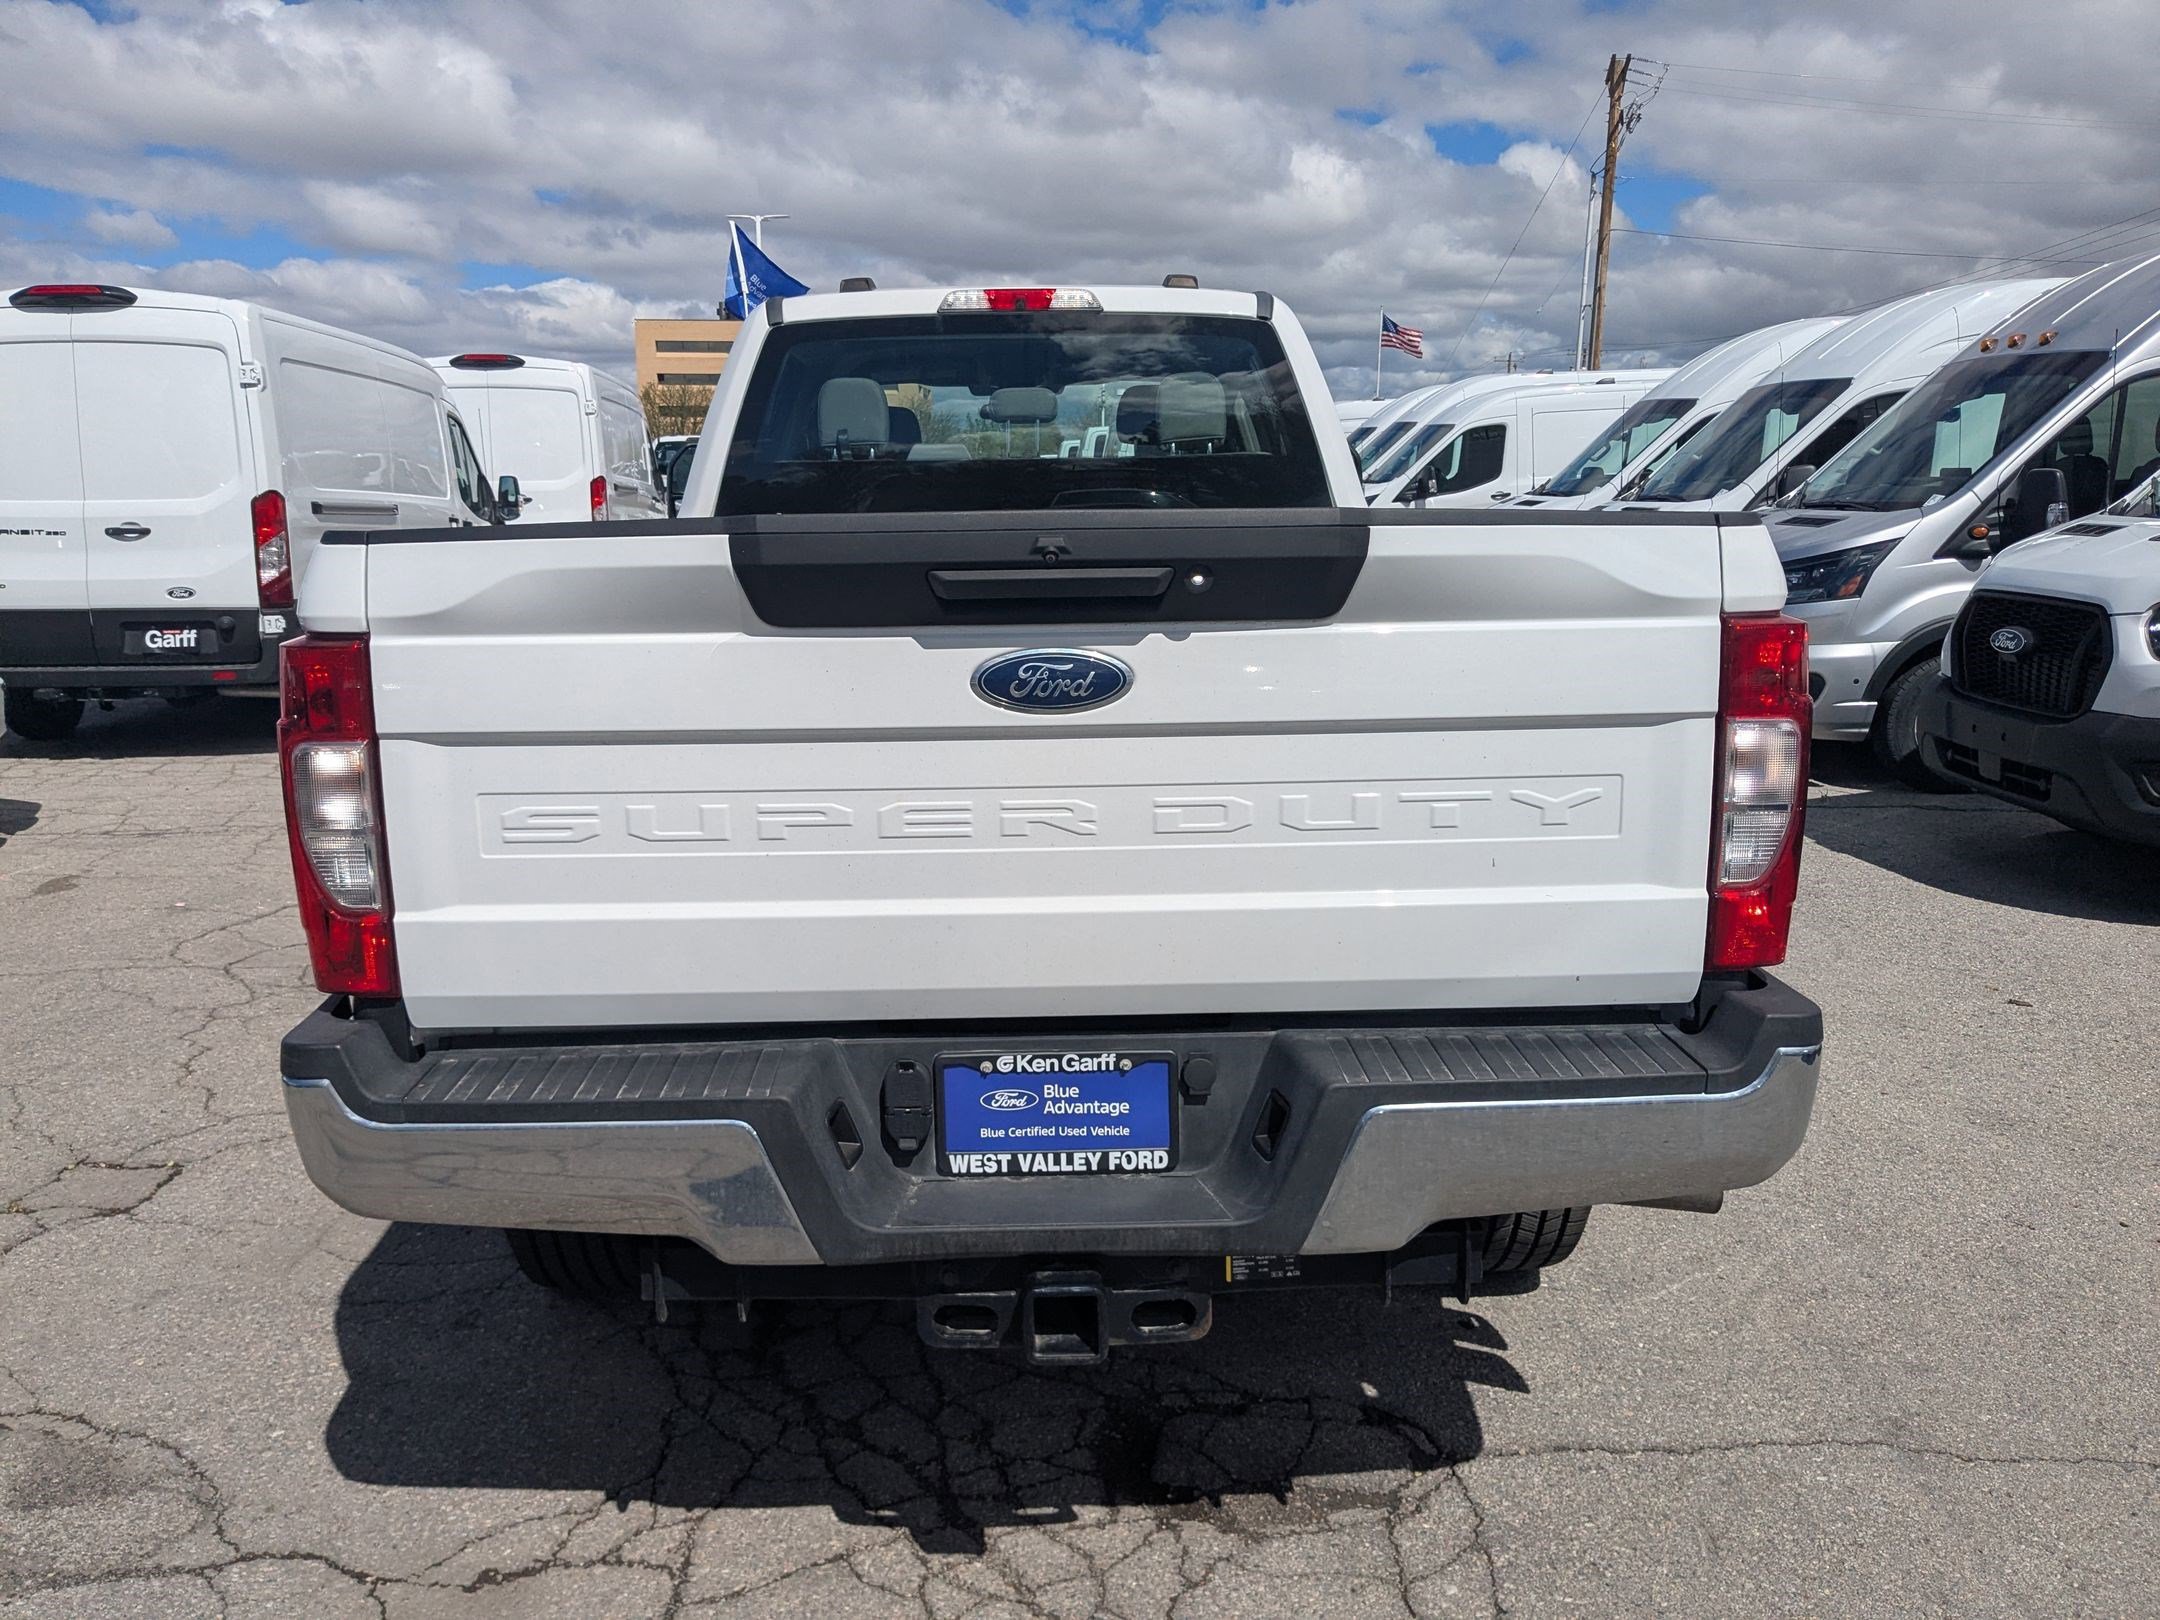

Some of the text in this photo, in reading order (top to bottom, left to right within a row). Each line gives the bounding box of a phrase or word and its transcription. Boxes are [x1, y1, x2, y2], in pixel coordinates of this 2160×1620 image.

[750, 274, 767, 291] Blue
[145, 629, 197, 648] Garff
[1010, 663, 1096, 698] Ford
[501, 787, 1604, 843] SUPER DUTY
[1017, 1053, 1116, 1073] Ken Garff
[991, 1092, 1028, 1108] Ford
[1044, 1084, 1080, 1098] Blue
[1043, 1100, 1130, 1117] Advantage
[980, 1125, 1130, 1138] Blue Certified Used Vehicle
[949, 1150, 1169, 1174] WEST VALLEY FORD
